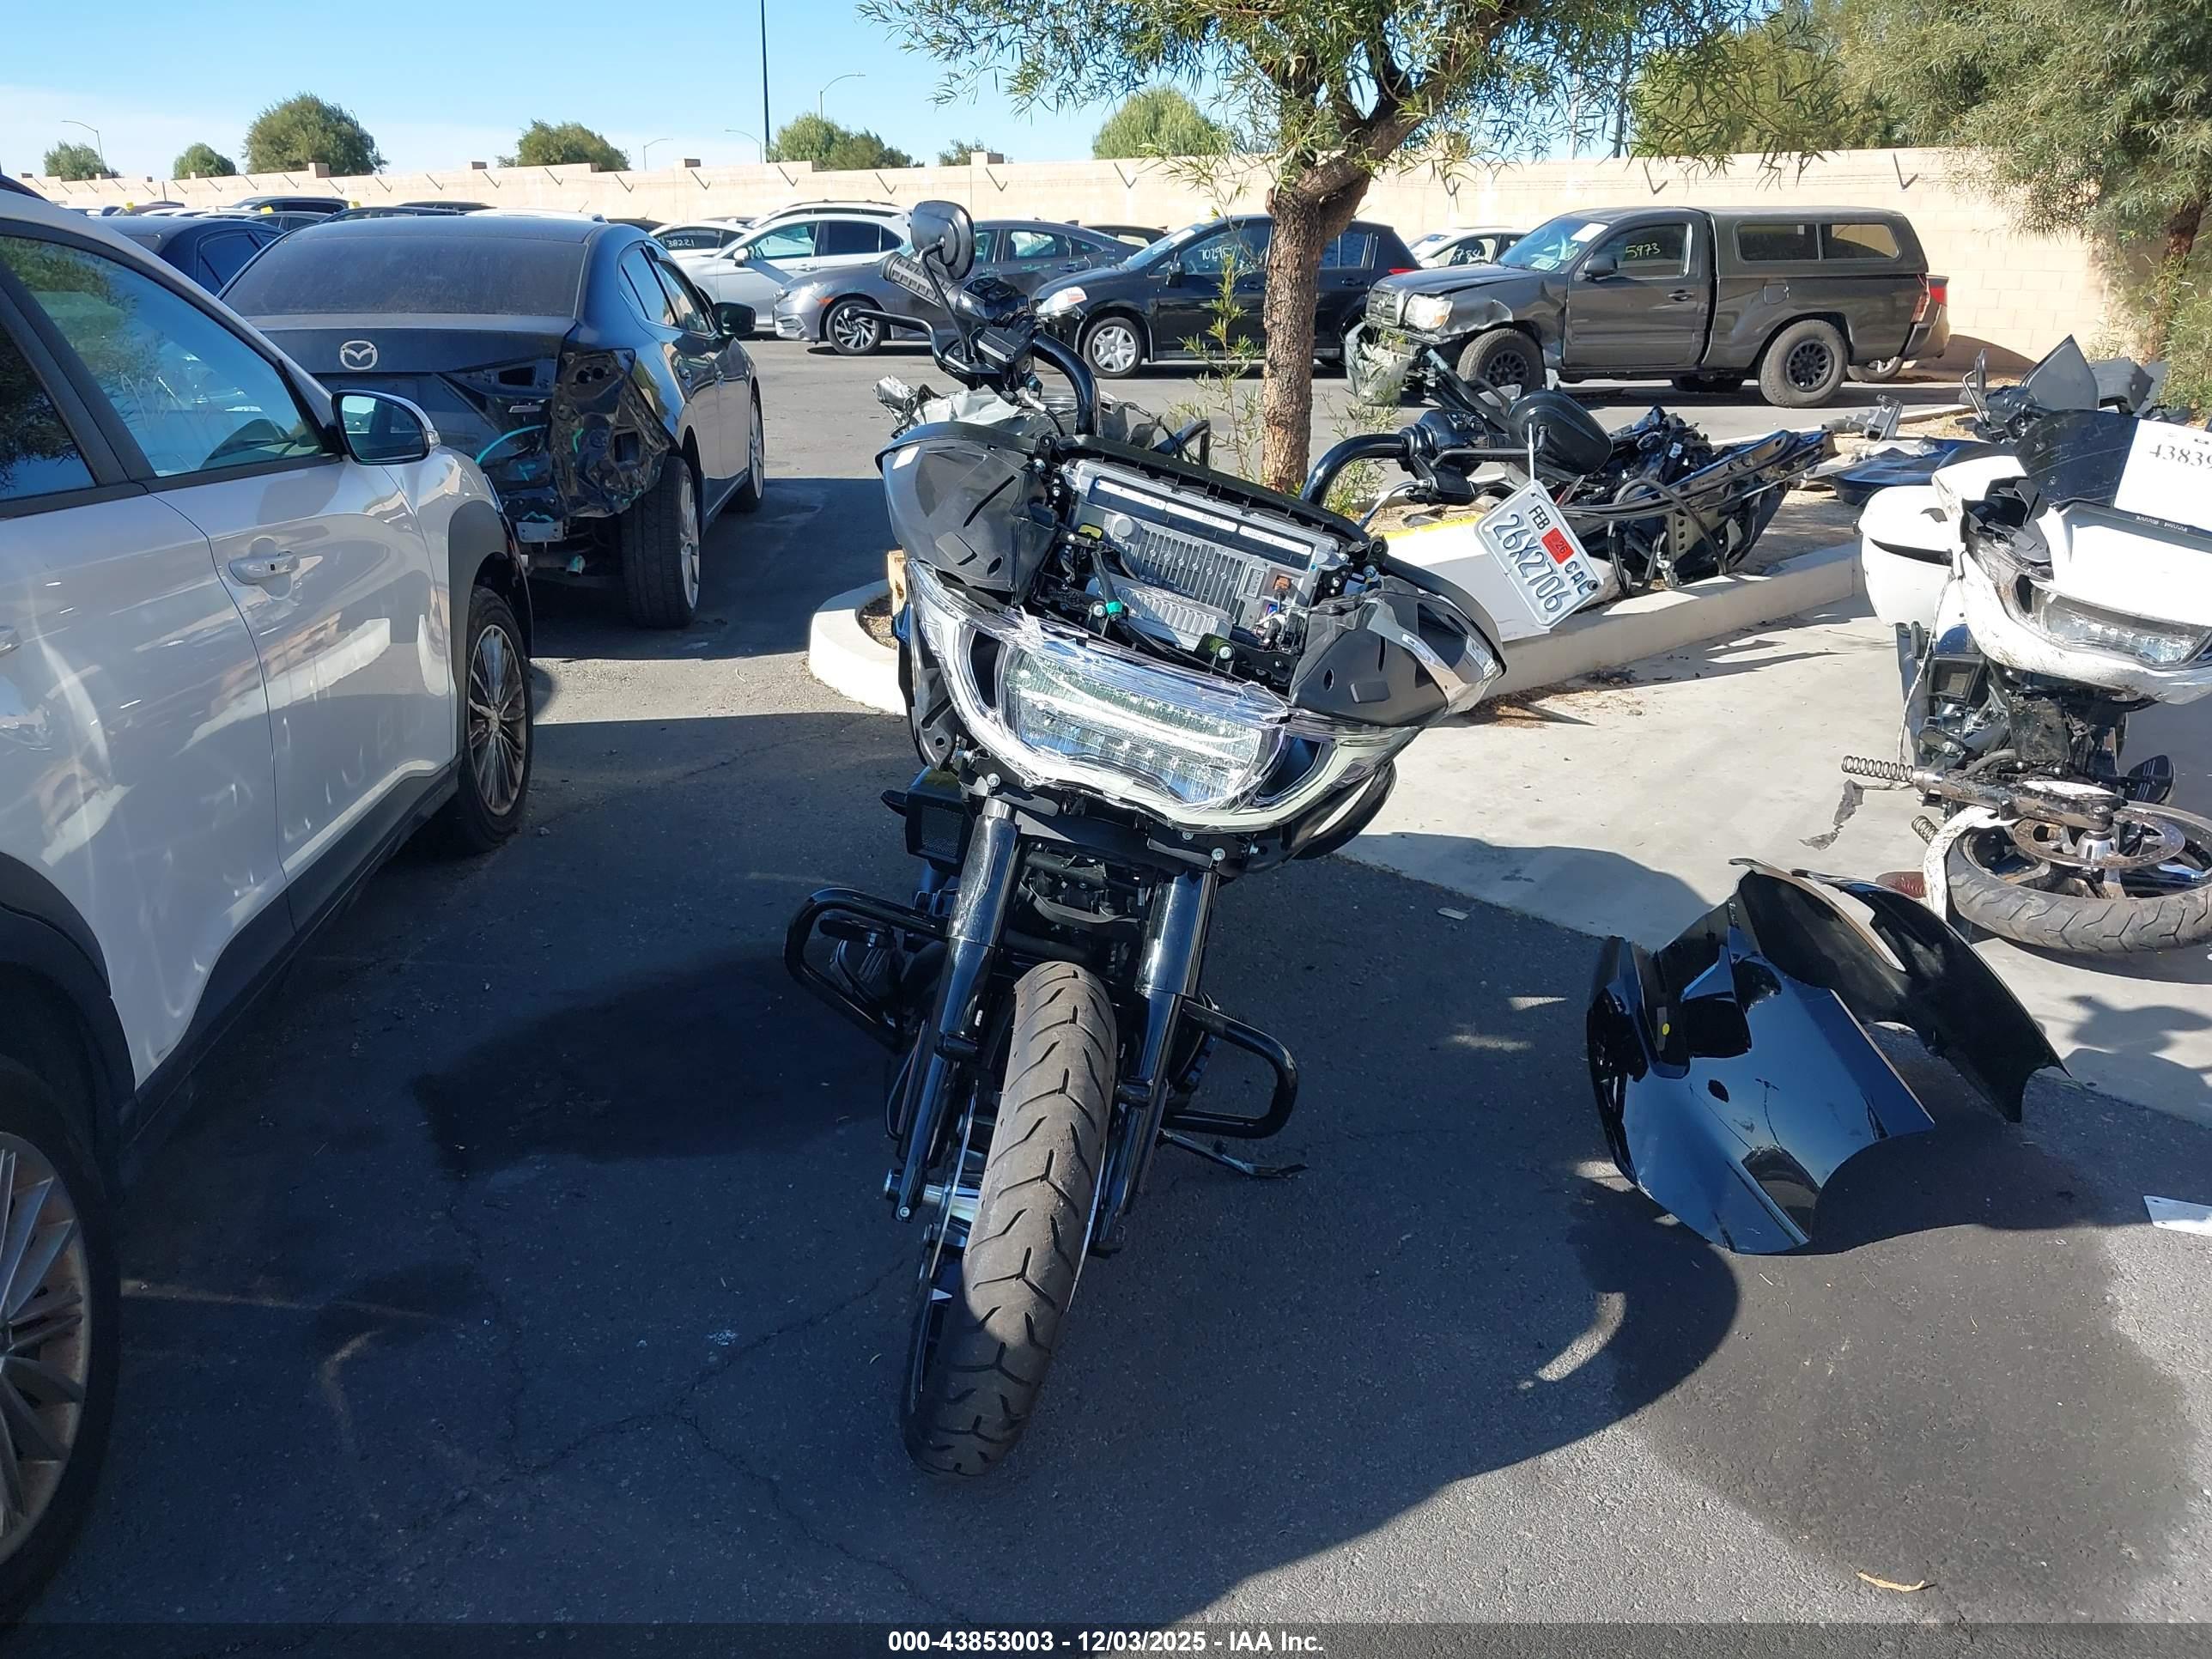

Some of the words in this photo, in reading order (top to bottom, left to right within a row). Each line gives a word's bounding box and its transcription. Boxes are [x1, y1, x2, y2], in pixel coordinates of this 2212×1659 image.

[1626, 242, 1661, 258] 5973
[1492, 514, 1572, 613] 26X2706
[1528, 505, 1551, 530] FEB
[1555, 541, 1568, 554] 26
[1564, 560, 1595, 595] CAL
